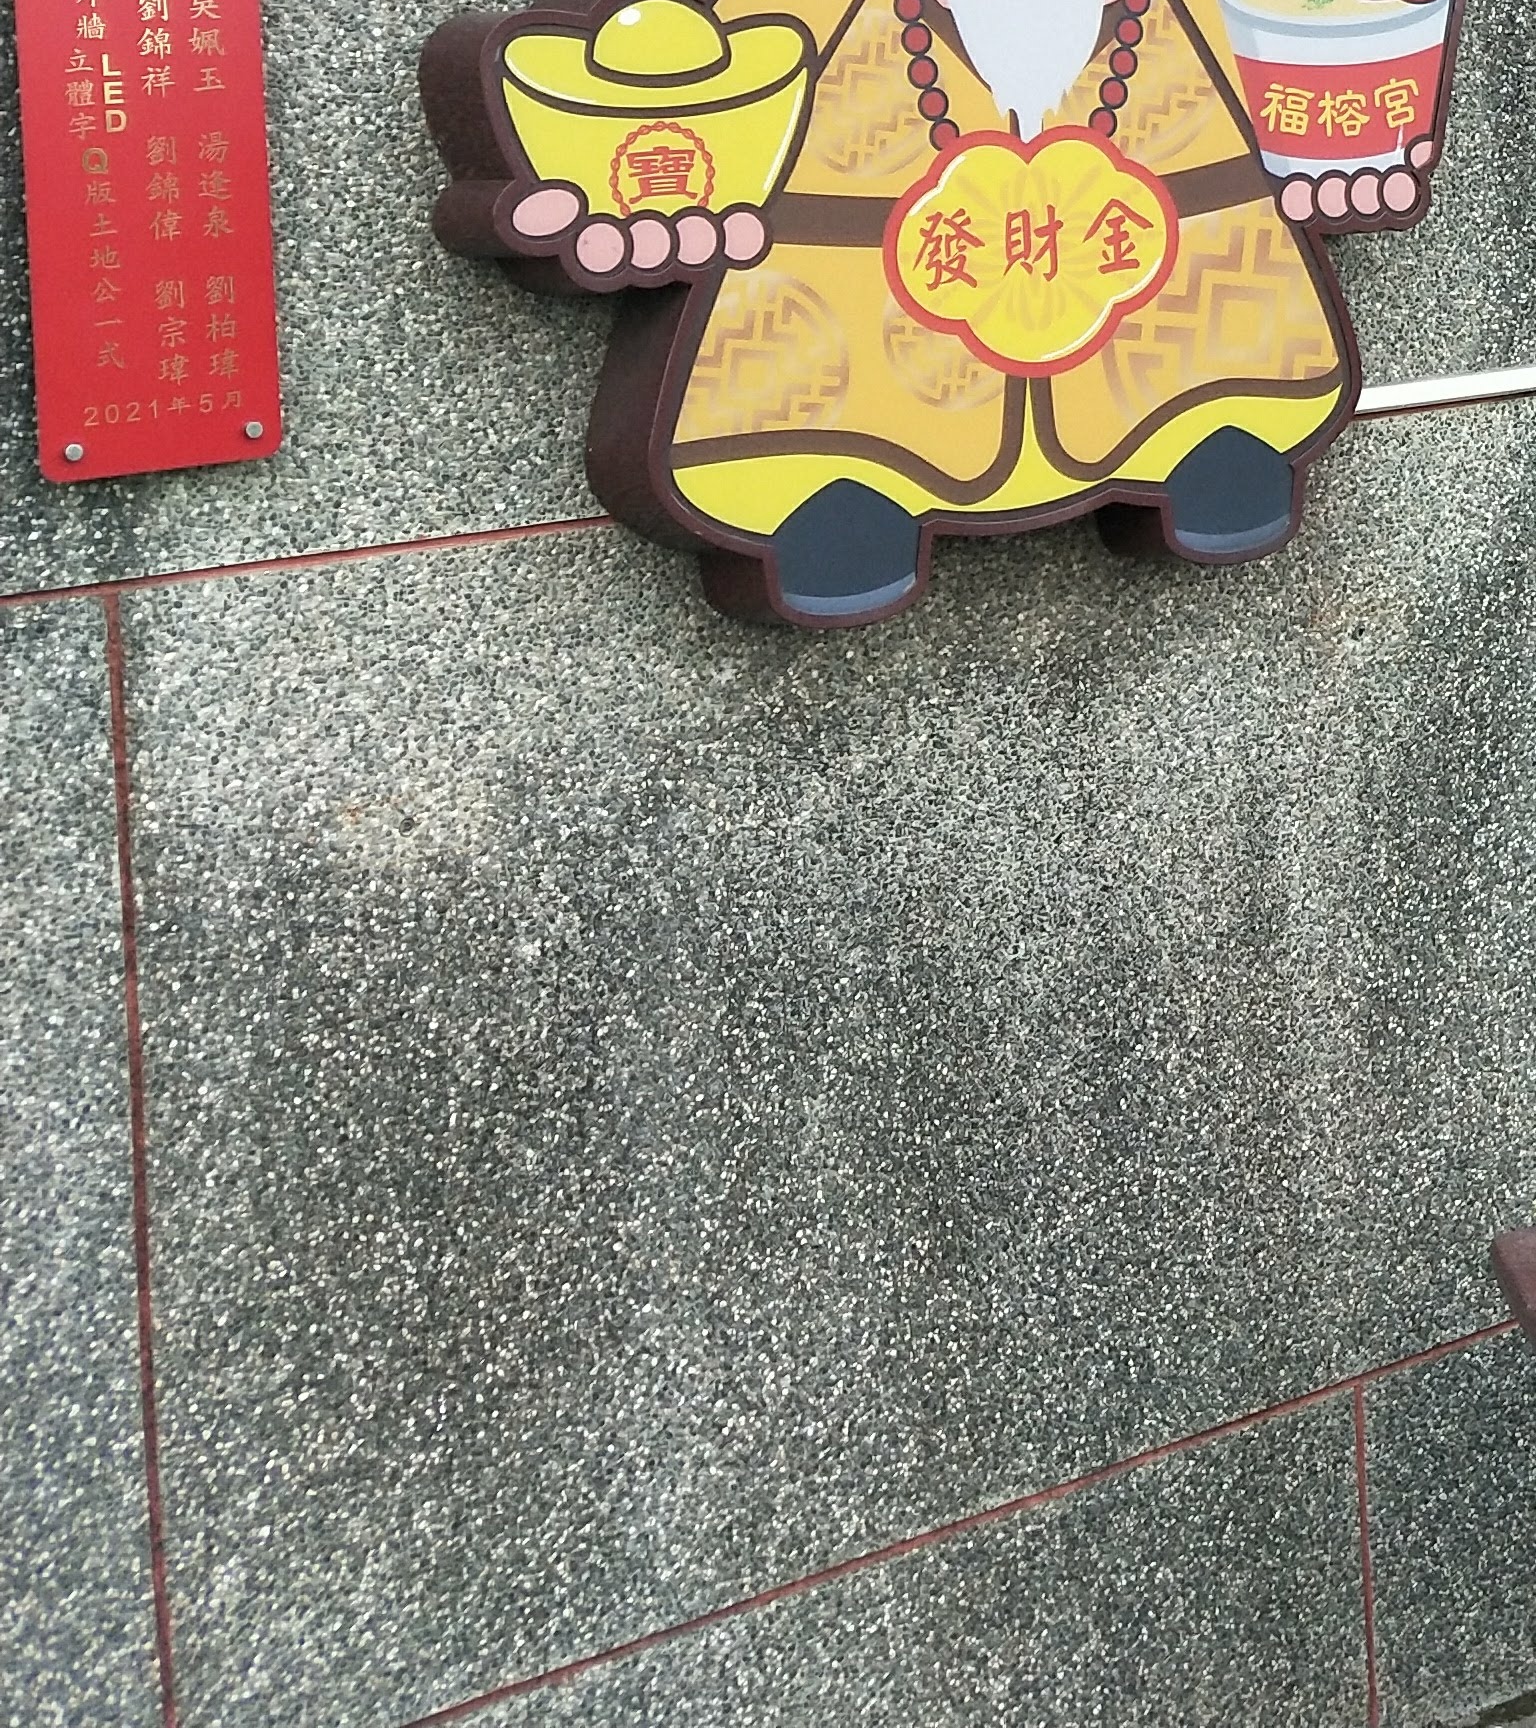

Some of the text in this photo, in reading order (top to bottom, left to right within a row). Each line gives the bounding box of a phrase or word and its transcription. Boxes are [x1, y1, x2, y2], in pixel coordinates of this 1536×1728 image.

[101, 53, 128, 134] LED
[1259, 77, 1421, 138] 福榕宮
[145, 135, 183, 242] 劉錦偉
[626, 146, 699, 205] 寶
[912, 197, 1155, 292] 發財金
[154, 279, 190, 386] 劉宗瑋
[205, 275, 240, 380] 劉柏瑋
[82, 389, 242, 427] 2021年5月
